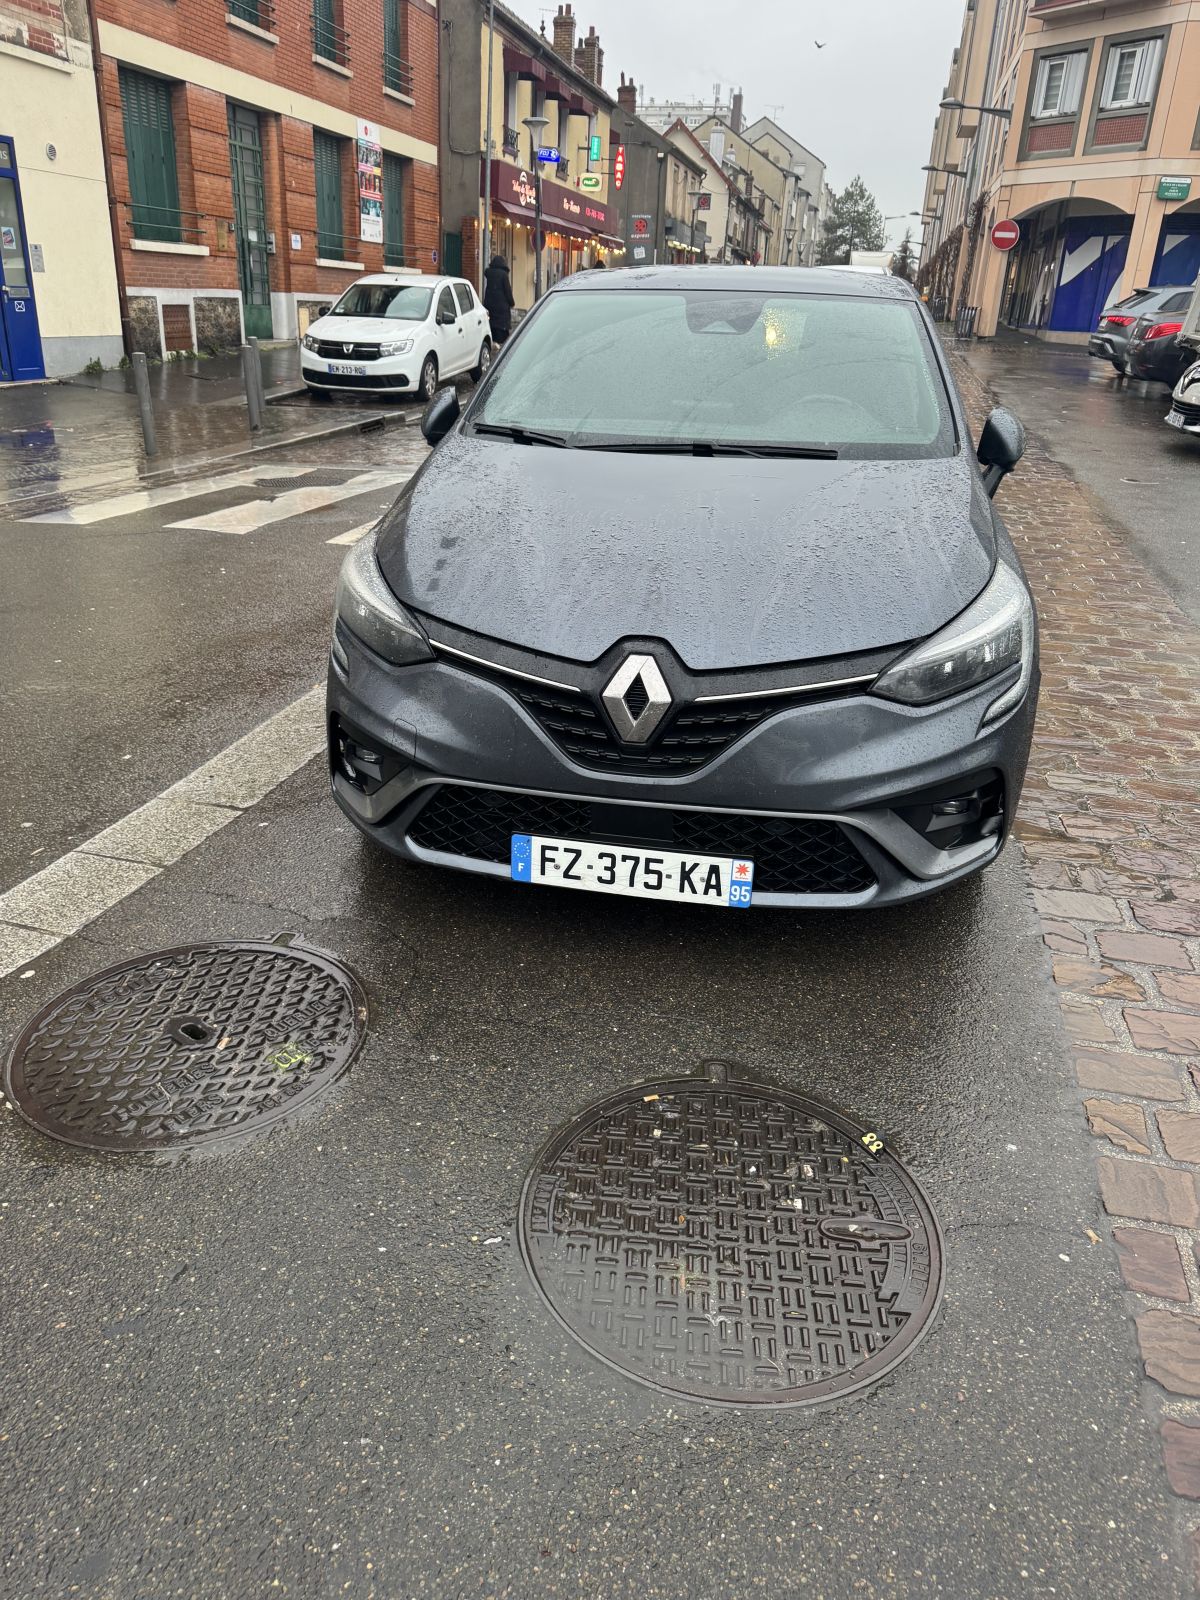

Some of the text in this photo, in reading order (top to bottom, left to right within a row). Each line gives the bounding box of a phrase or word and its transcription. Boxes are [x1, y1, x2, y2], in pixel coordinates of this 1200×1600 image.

[616, 146, 624, 187] TABAC
[517, 863, 525, 872] F
[540, 844, 722, 897] FZ-375-KA
[730, 886, 750, 902] 95
